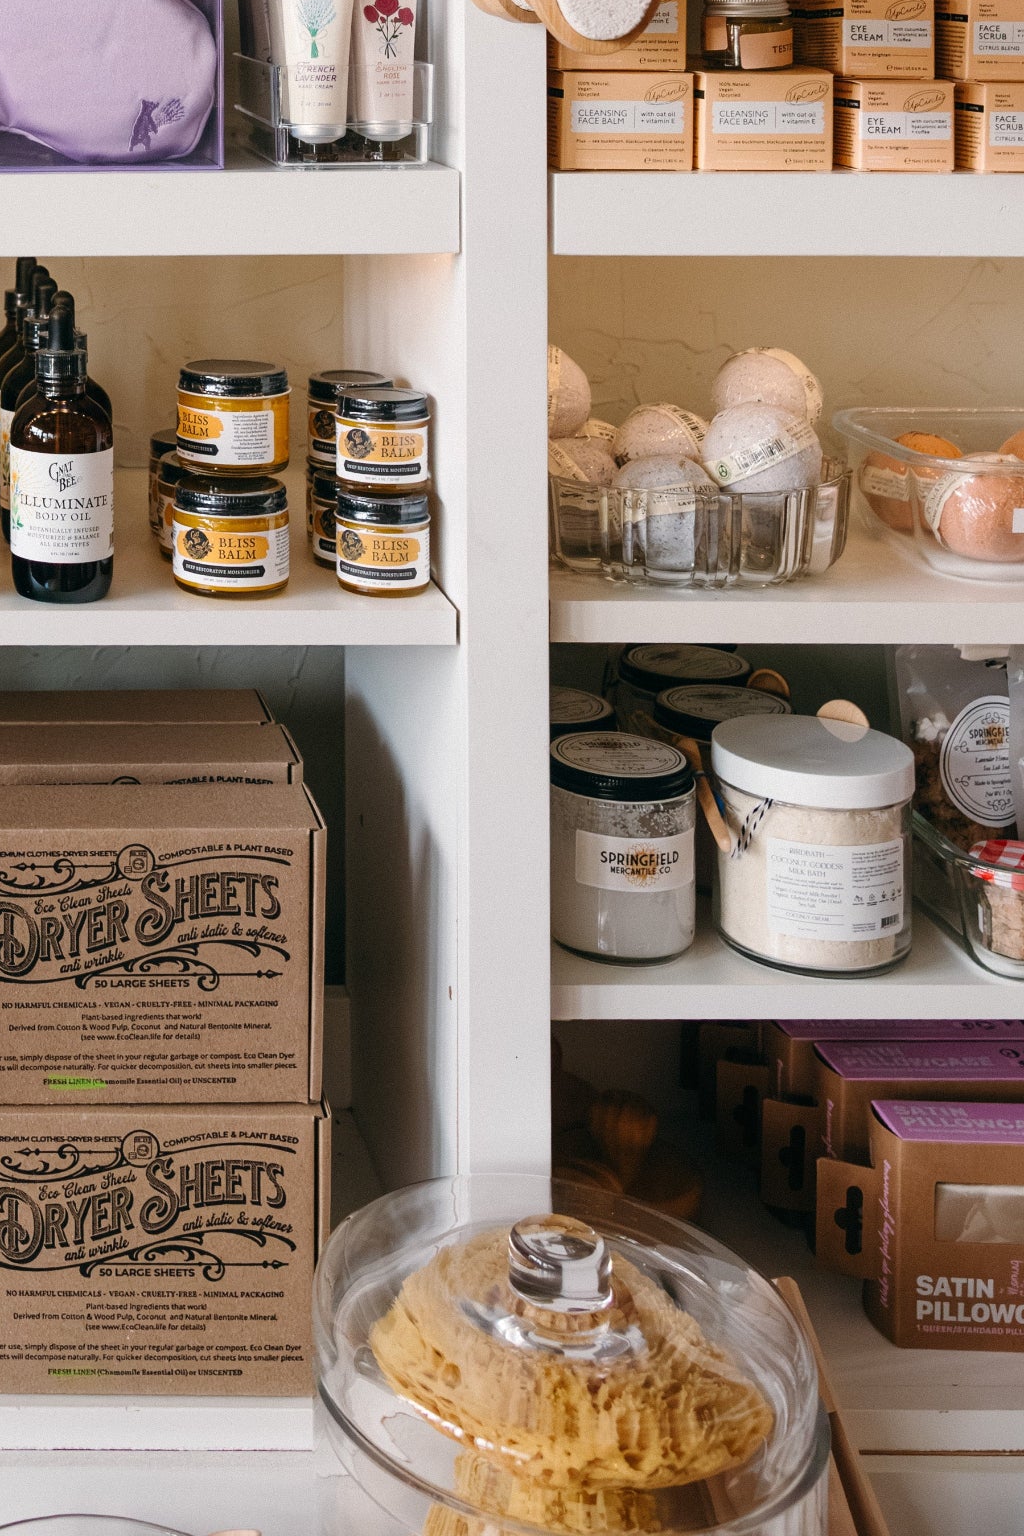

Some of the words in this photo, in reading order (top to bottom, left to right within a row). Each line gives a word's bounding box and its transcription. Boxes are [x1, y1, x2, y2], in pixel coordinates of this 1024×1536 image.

[297, 61, 335, 74] FRENCH
[295, 74, 337, 82] LAVENDER
[381, 436, 416, 446] BLISS
[381, 447, 416, 458] BALM
[20, 494, 108, 510] ILLUMINATE
[35, 512, 67, 521] BODY
[70, 512, 92, 521] OIL
[218, 537, 256, 548] BLISS
[218, 548, 257, 560] BALM
[600, 851, 679, 866] SPRINGFIELD
[610, 866, 656, 875] MERCANTILE
[134, 871, 283, 946] SHEETS
[94, 979, 108, 988] 50
[110, 979, 147, 988] LARGE
[148, 979, 190, 988] SHEETS
[916, 1274, 994, 1299] SATIN
